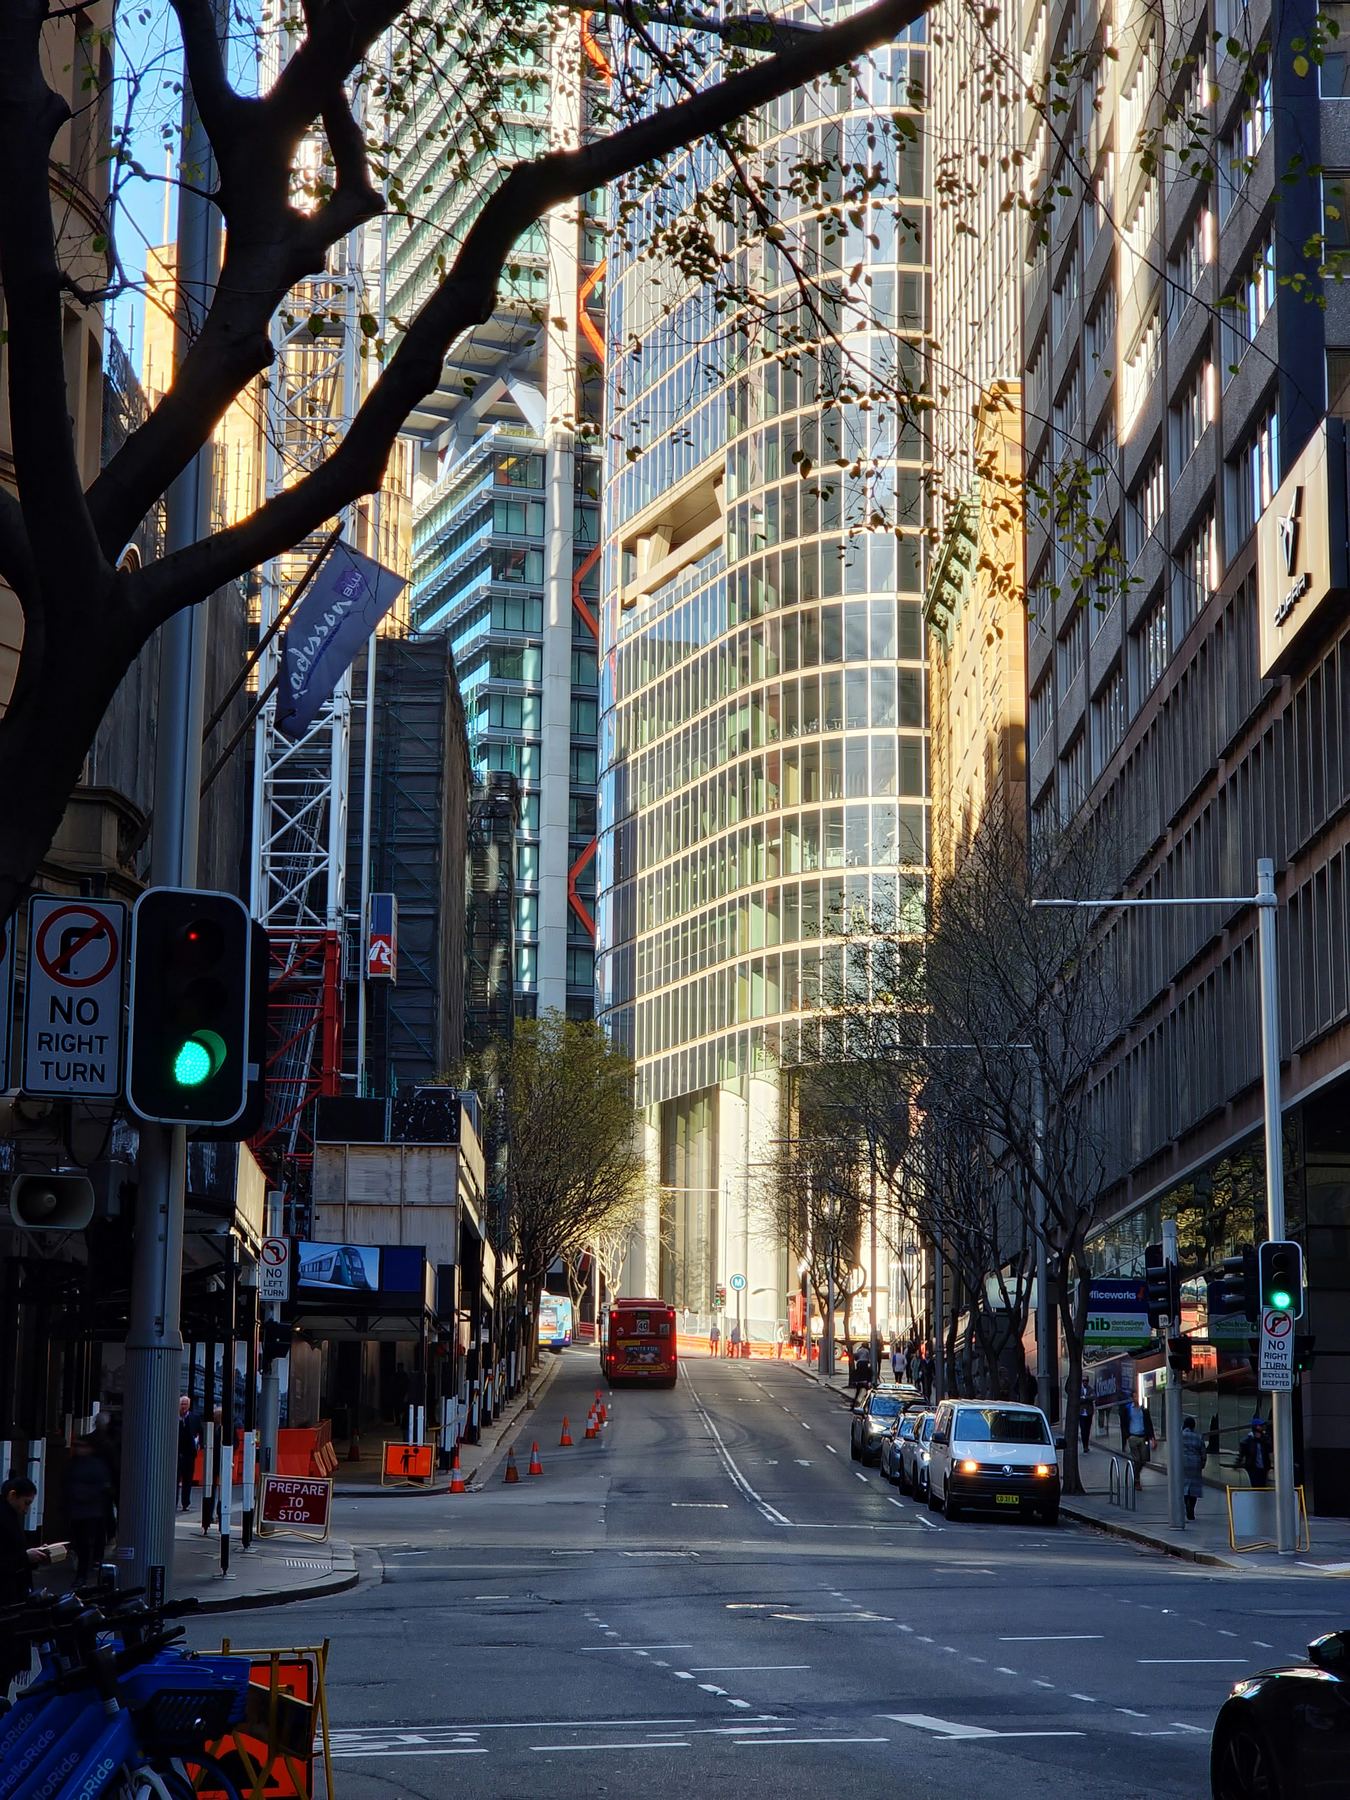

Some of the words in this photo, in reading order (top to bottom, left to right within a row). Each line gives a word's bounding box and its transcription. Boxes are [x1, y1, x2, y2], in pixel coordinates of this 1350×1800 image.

[343, 571, 363, 597] BLU
[1273, 573, 1308, 627] CUPRA
[49, 996, 99, 1026] NO
[37, 1032, 108, 1055] RIGHT
[40, 1061, 106, 1083] TURN
[266, 1268, 282, 1278] NO
[263, 1289, 284, 1297] TURN
[1089, 1289, 1137, 1300] fficeworks
[639, 1322, 647, 1330] 40
[1086, 1317, 1110, 1331] nib
[1268, 1340, 1285, 1351] NO
[1264, 1352, 1288, 1361] RIGHT
[1265, 1361, 1287, 1369] TURN
[268, 1481, 326, 1497] PREPARE
[288, 1496, 304, 1508] TO
[278, 1509, 311, 1522] STOP
[0, 1728, 56, 1795] HelloRide
